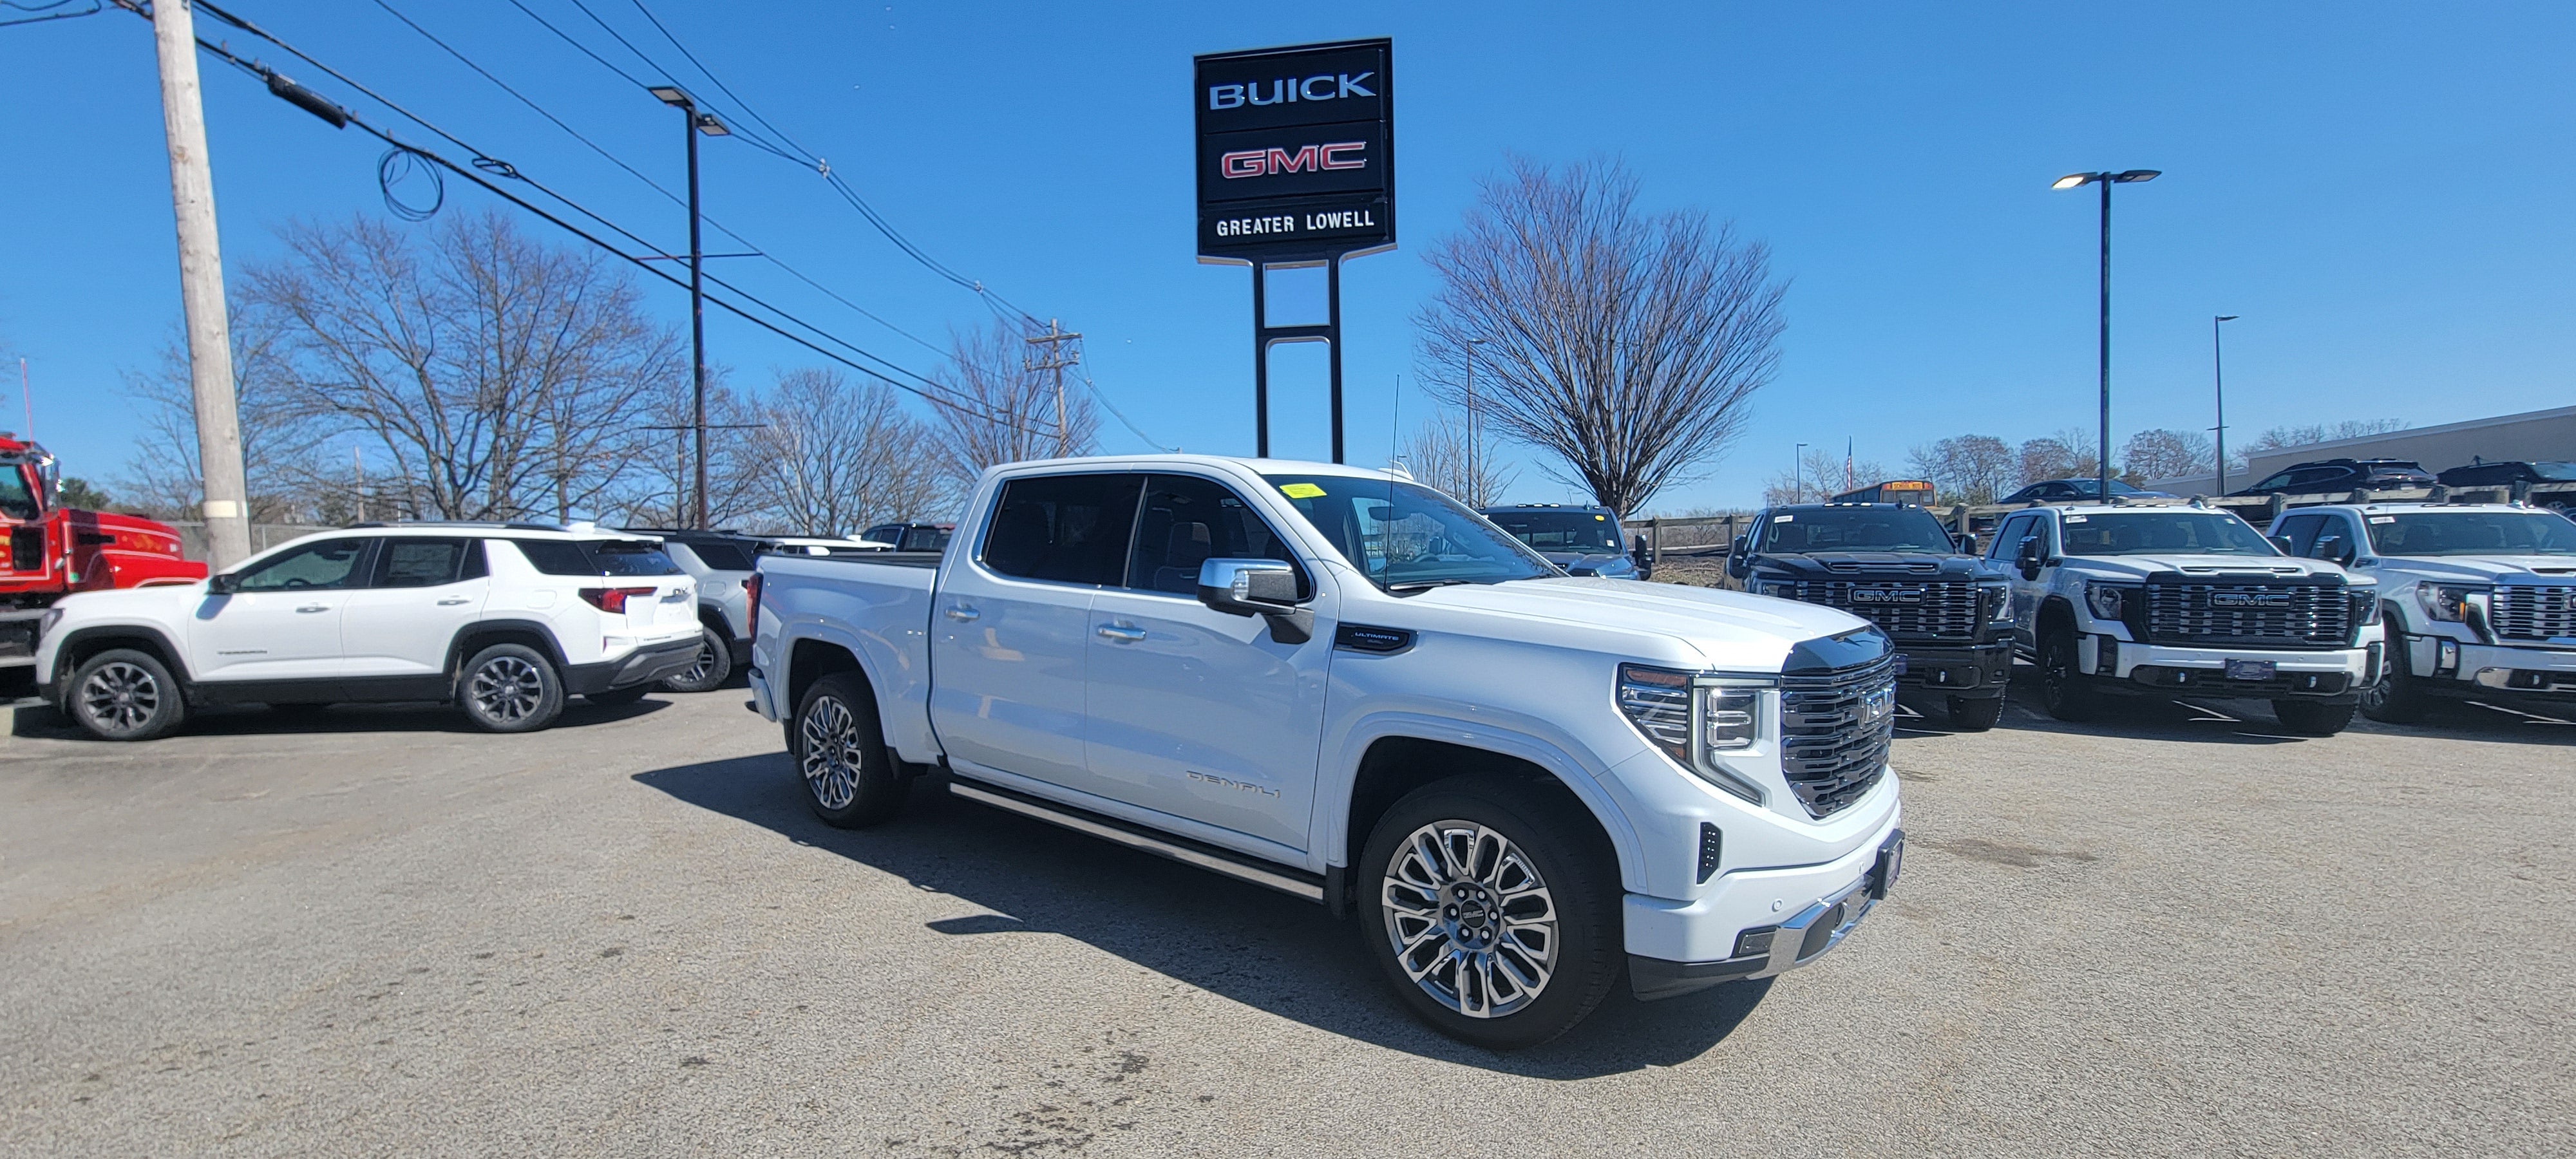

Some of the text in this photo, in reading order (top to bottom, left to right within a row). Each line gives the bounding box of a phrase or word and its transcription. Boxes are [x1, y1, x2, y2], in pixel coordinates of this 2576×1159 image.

[1209, 71, 1377, 110] BUICK
[1221, 141, 1366, 179] GMC
[1217, 210, 1374, 236] GREATER LOWELL
[1854, 590, 1920, 601] GMC
[2214, 594, 2289, 605] GMC
[1354, 632, 1399, 641] ULTIMATE
[1186, 770, 1280, 798] DENALI
